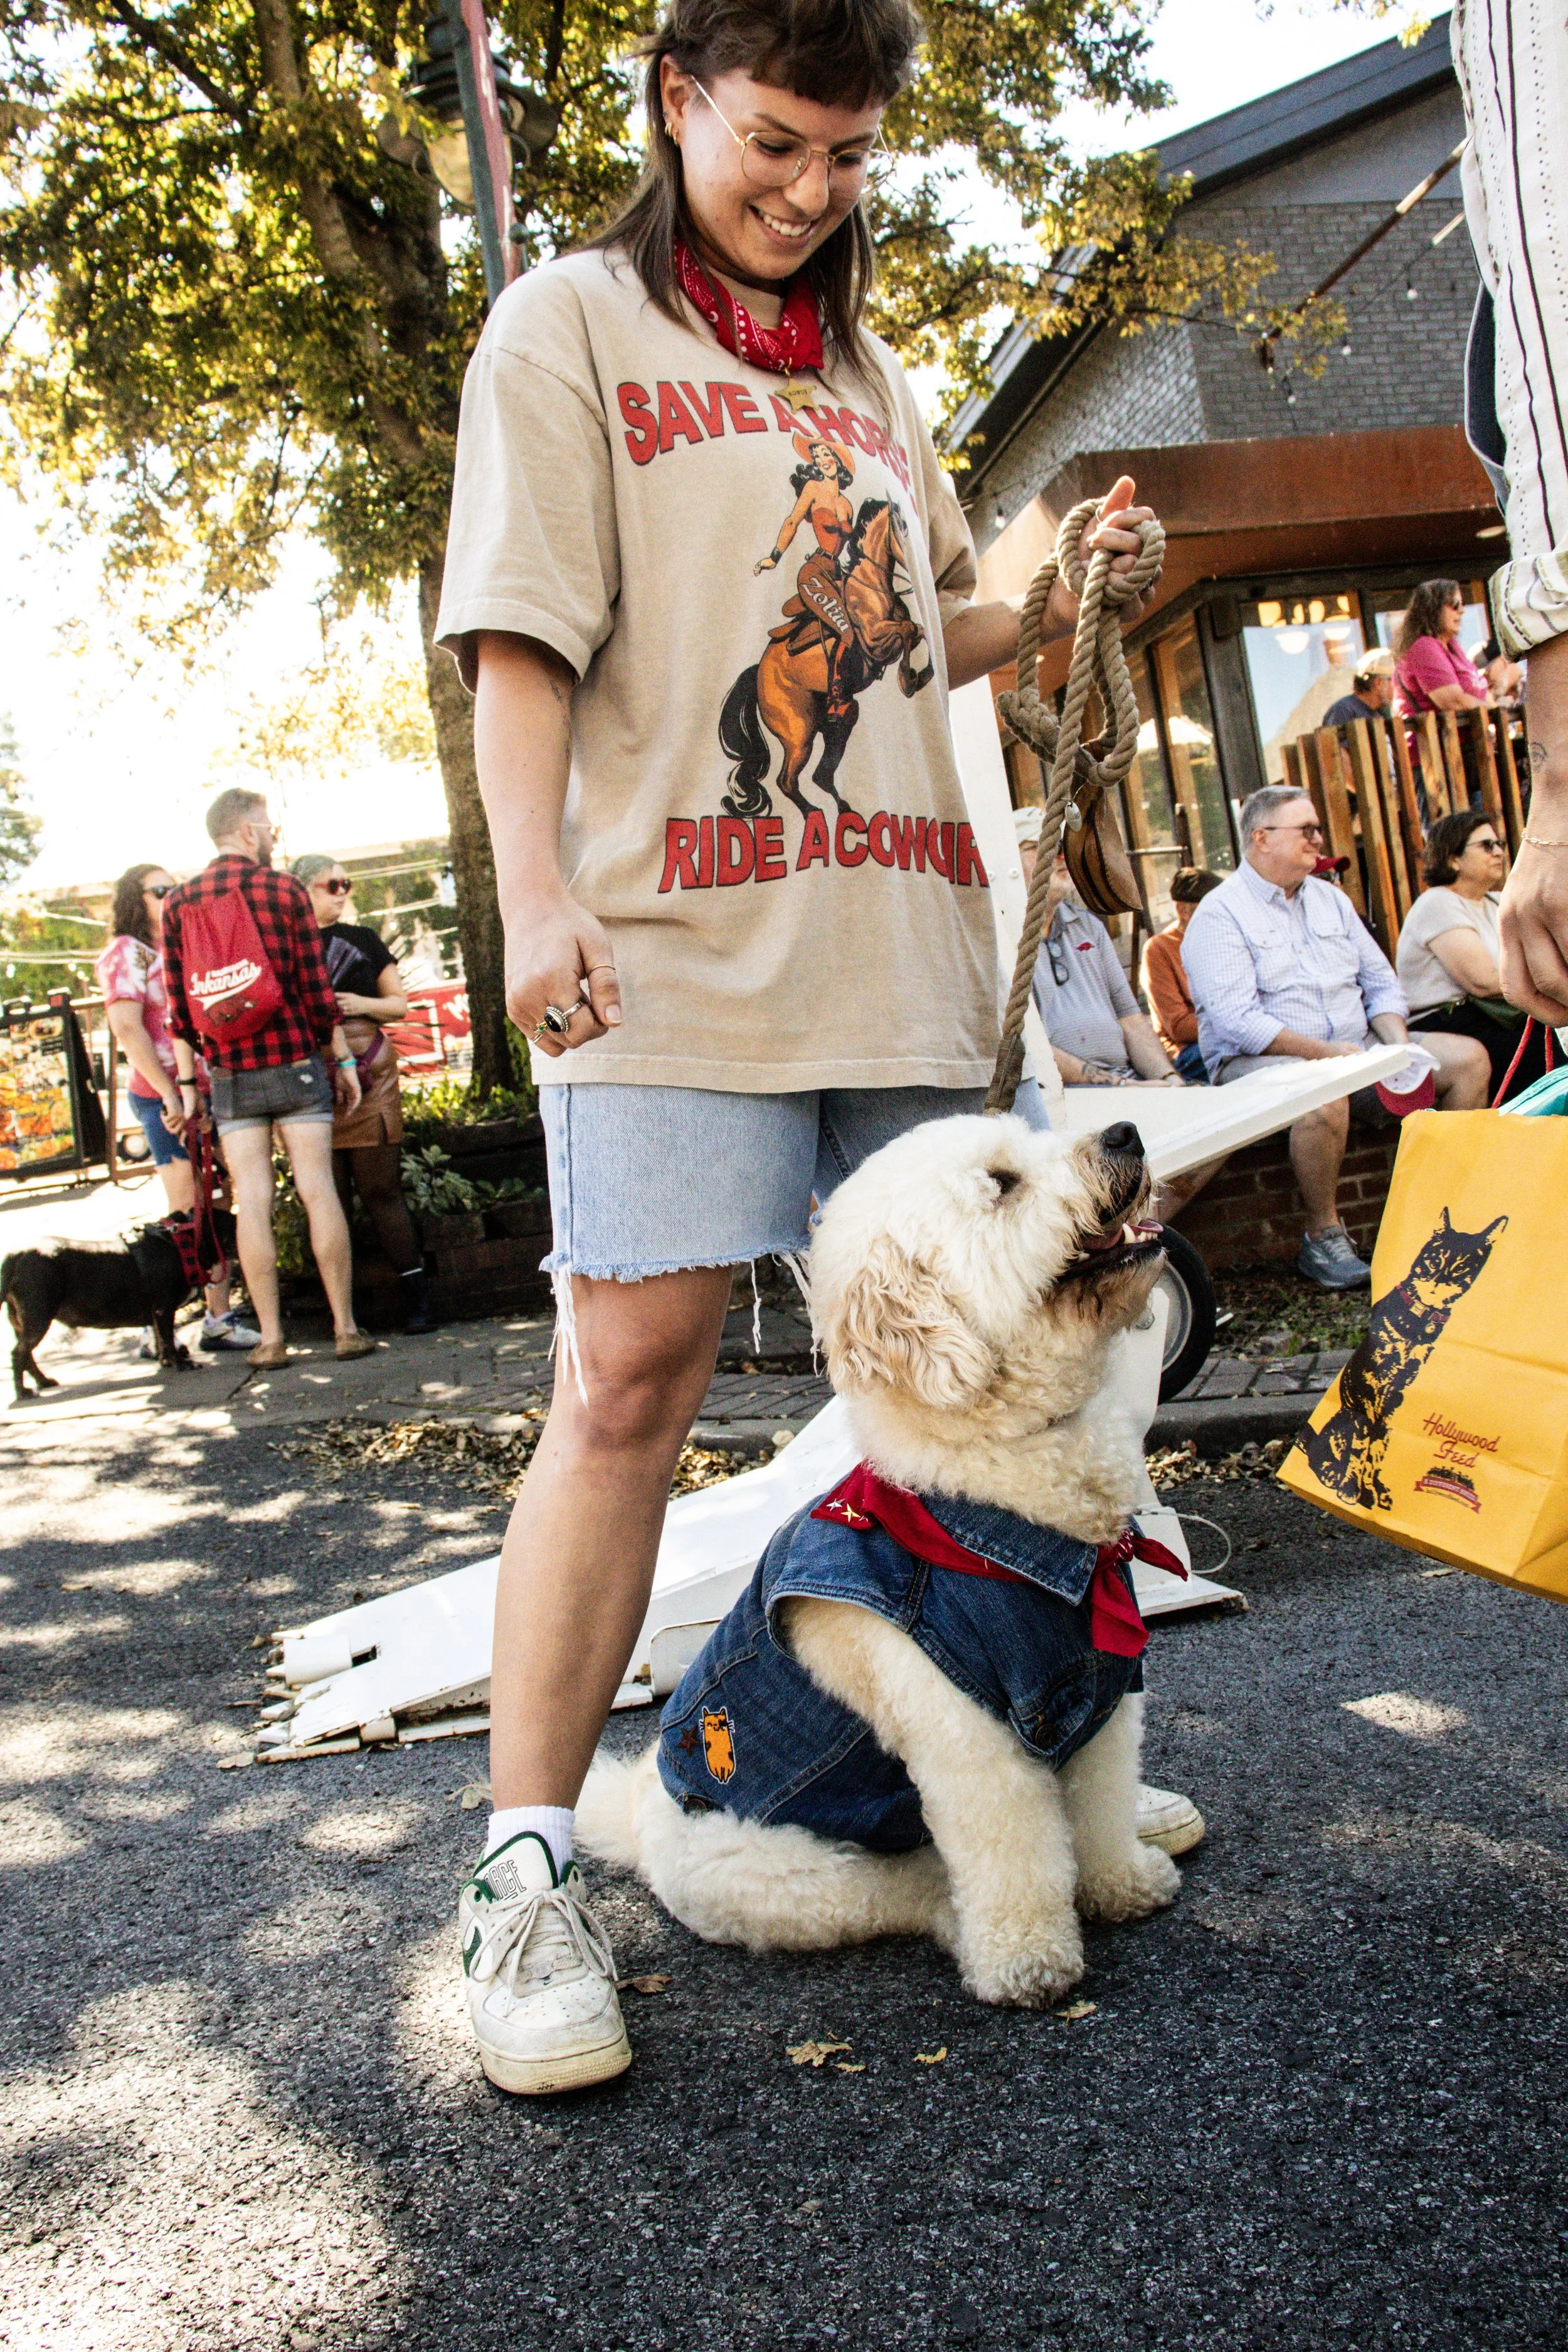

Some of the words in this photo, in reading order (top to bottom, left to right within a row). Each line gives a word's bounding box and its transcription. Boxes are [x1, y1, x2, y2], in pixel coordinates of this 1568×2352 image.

[617, 381, 768, 466] SAVE
[766, 393, 813, 438] A
[800, 576, 849, 633] Zolita
[657, 815, 787, 894] RIDE
[795, 808, 830, 872] A
[834, 810, 990, 889] COWGIR
[1423, 1412, 1501, 1453] Hollywood
[1433, 1440, 1480, 1468] Feed
